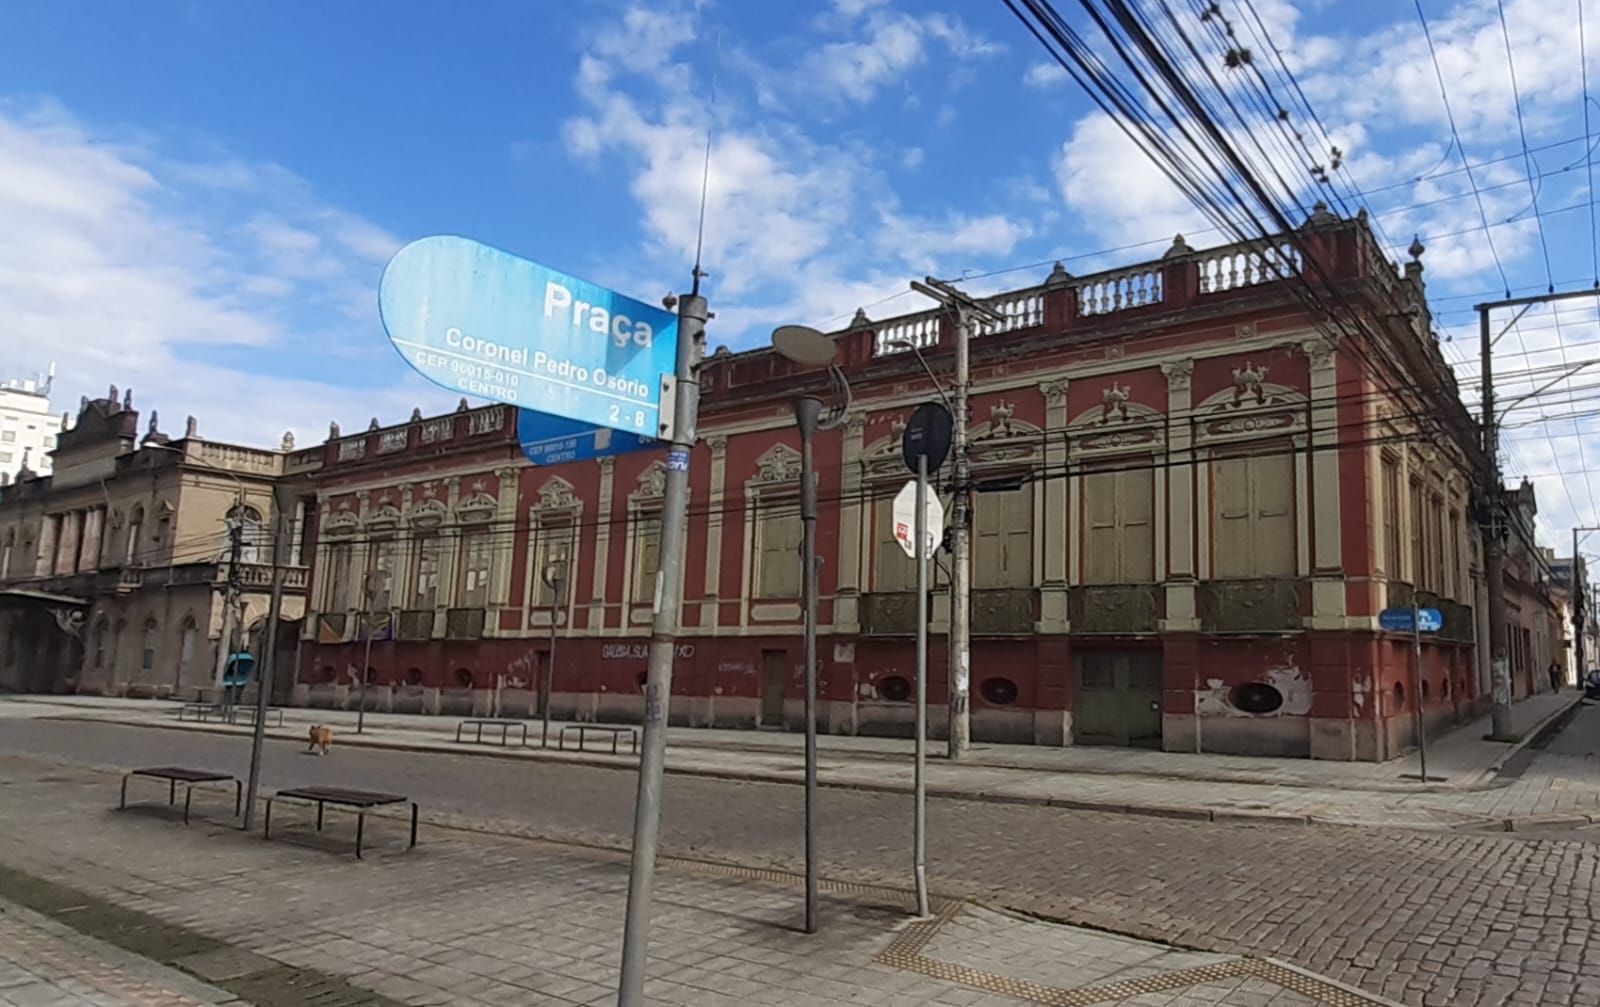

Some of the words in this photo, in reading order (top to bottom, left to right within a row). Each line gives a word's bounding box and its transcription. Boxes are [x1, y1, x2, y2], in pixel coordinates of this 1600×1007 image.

[543, 281, 652, 348] Praça
[416, 351, 447, 368] CEP
[446, 327, 528, 366] Coronel
[534, 350, 588, 382] Pedro
[593, 367, 649, 398] Osório
[458, 378, 517, 401] CENTRO
[608, 403, 620, 422] 2
[634, 410, 645, 428] 8
